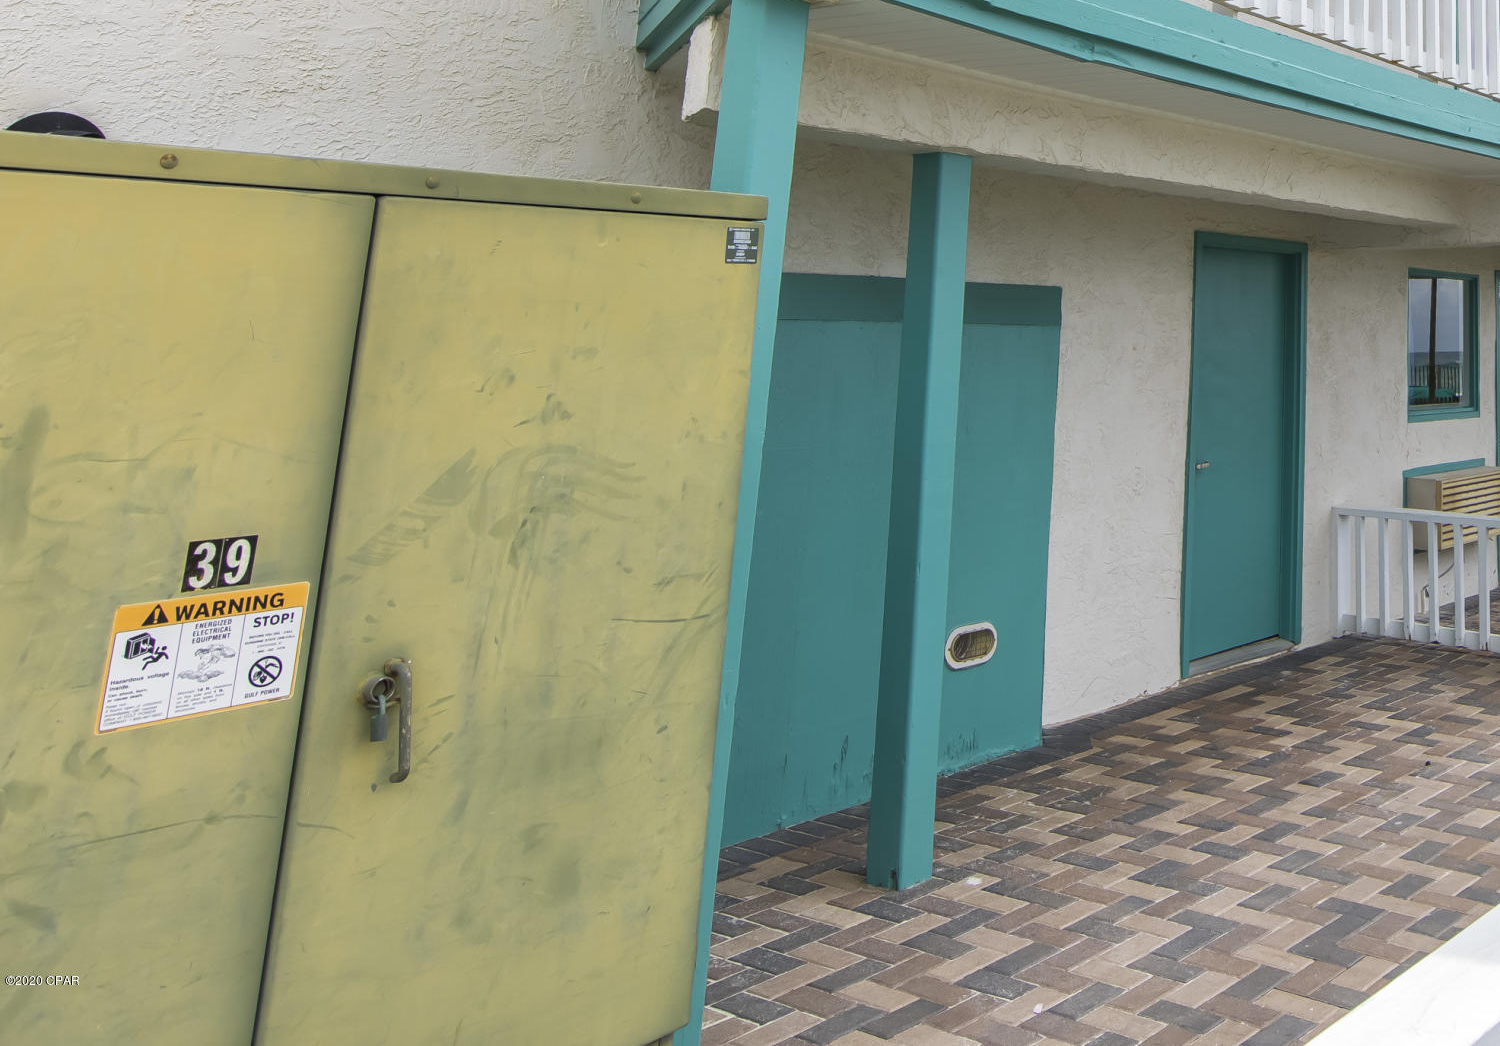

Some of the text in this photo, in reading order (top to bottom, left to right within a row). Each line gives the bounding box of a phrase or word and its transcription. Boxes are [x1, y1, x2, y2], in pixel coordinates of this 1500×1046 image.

[188, 538, 252, 590] 39
[175, 592, 285, 622] WARNING
[195, 618, 232, 629] ENERGIZED
[252, 611, 295, 628] STOP!
[192, 626, 232, 637] ELECTRICAL
[192, 633, 231, 644] EQUIPMENT
